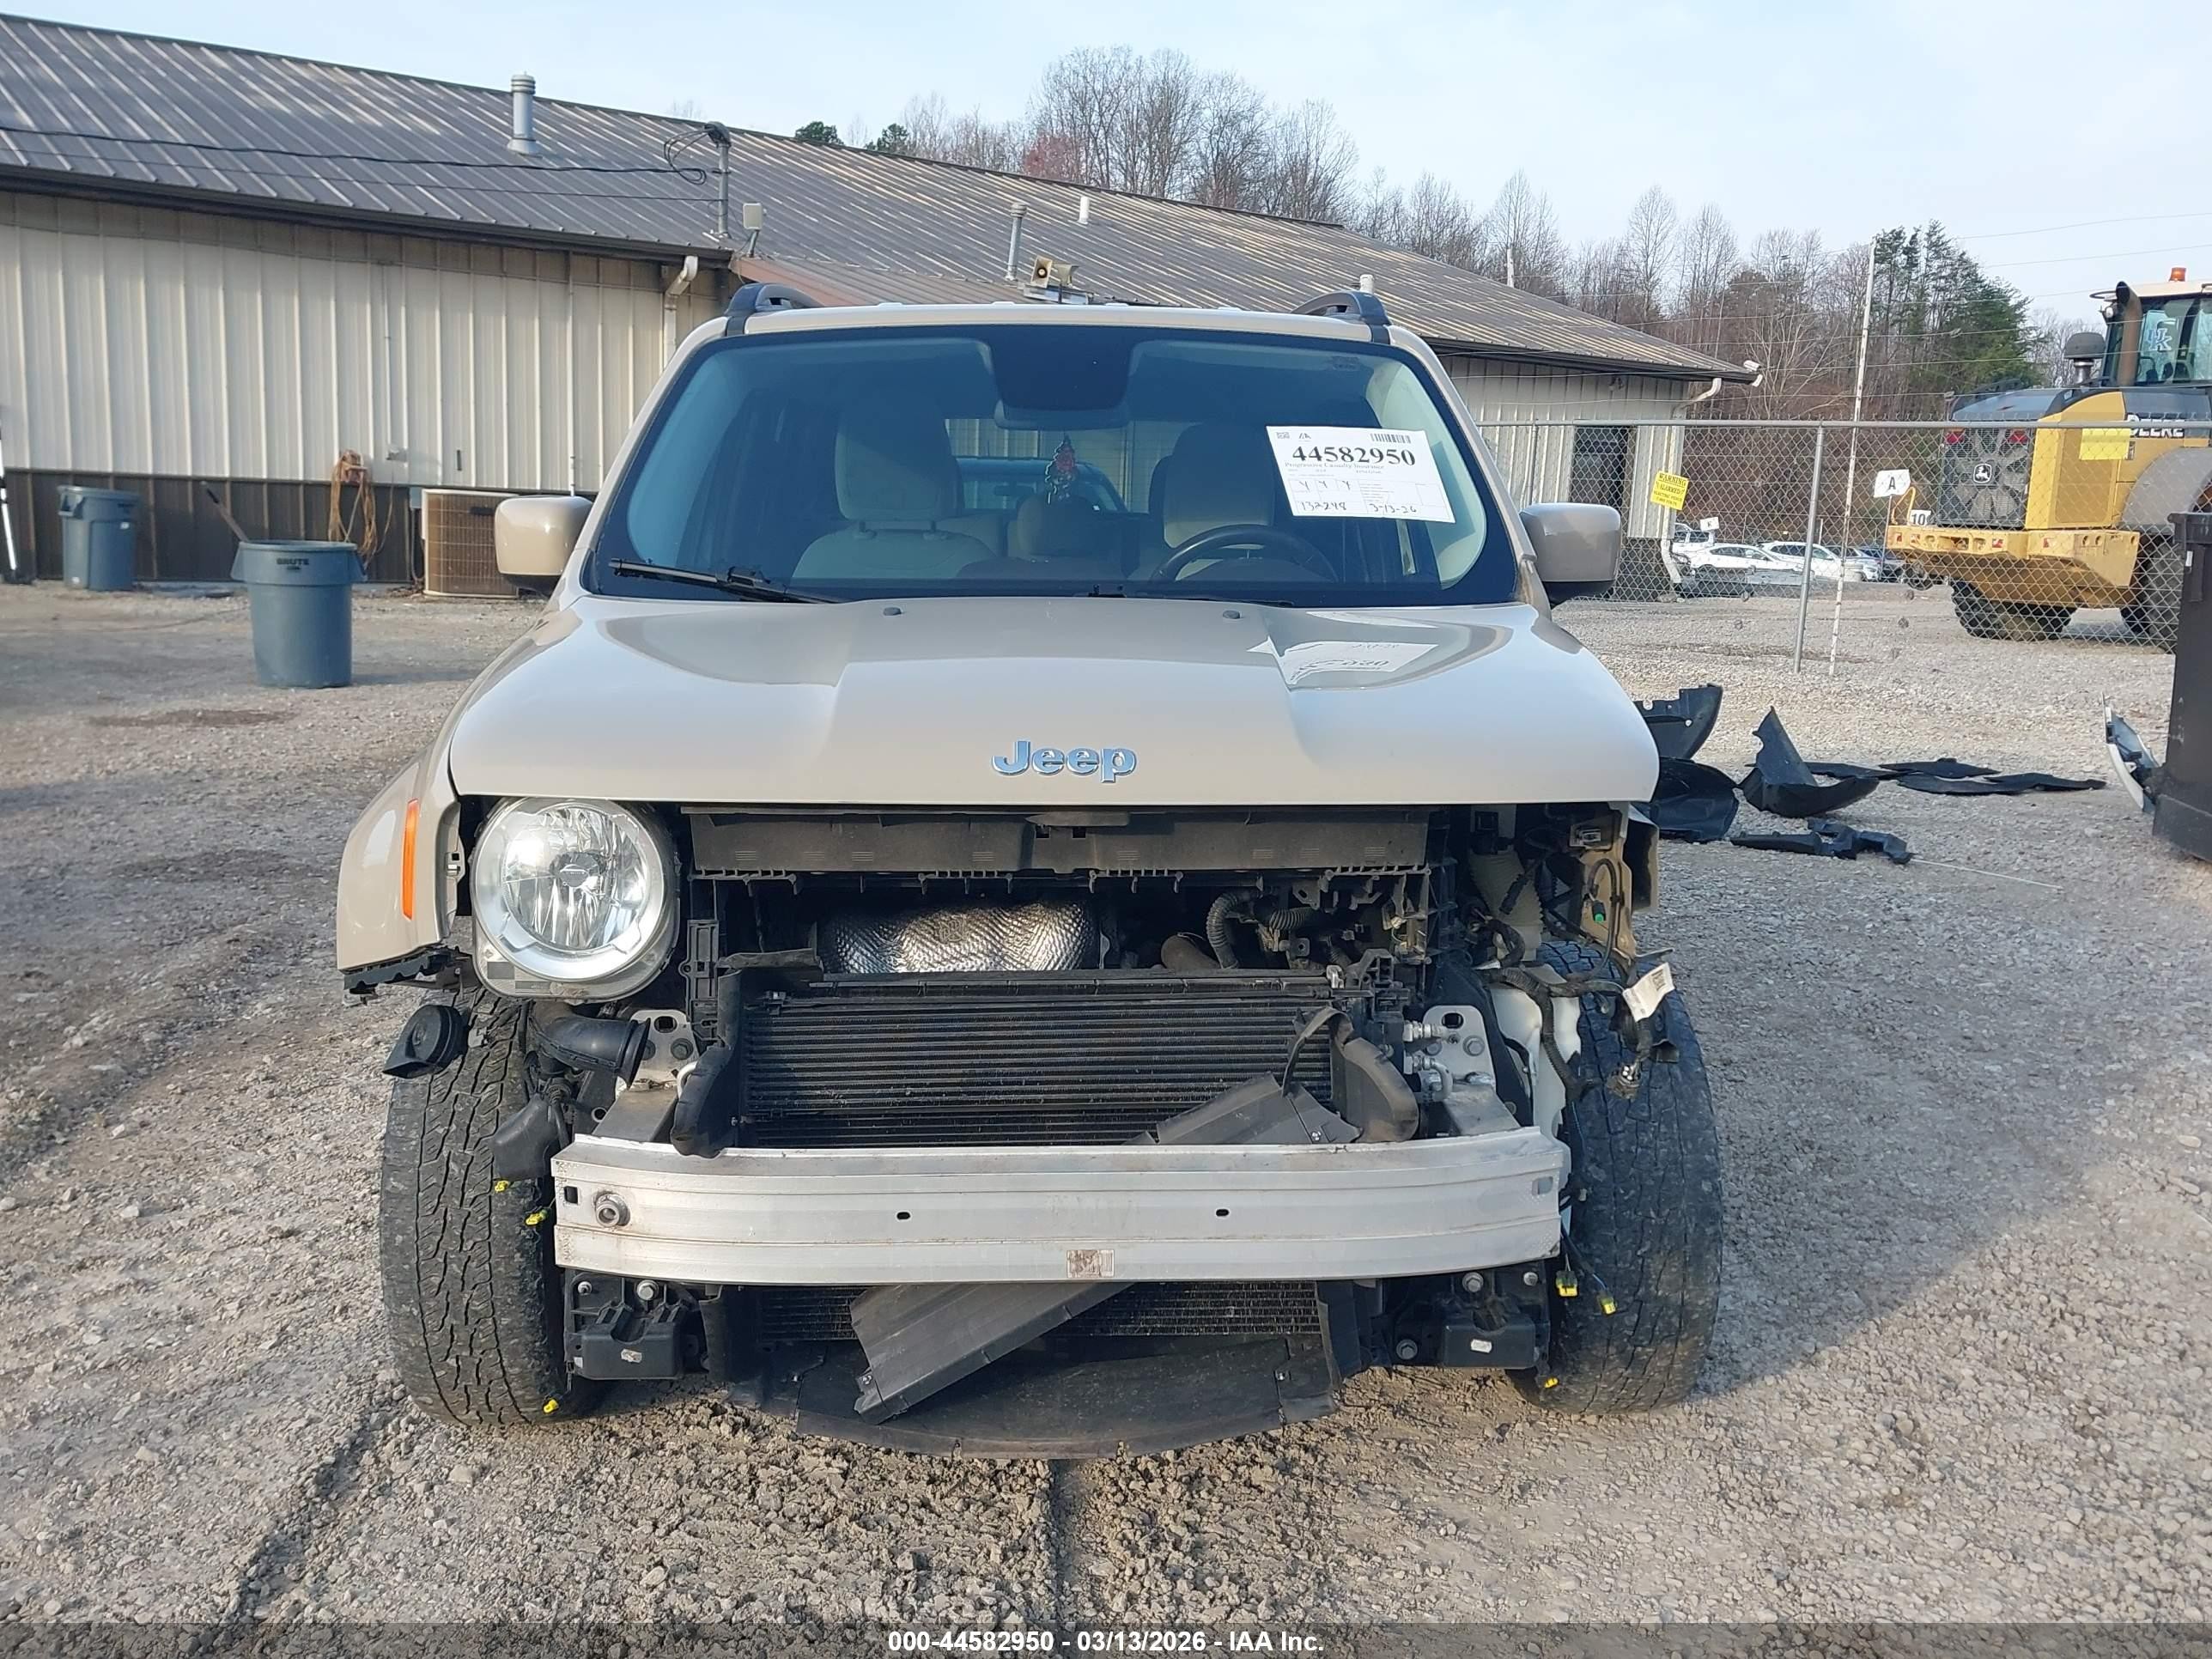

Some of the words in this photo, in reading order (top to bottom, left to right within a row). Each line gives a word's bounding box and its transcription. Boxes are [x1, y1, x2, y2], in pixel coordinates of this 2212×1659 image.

[1292, 446, 1415, 465] 44582950
[1659, 473, 1686, 486] WARNING
[1889, 477, 1896, 490] A
[991, 739, 1138, 784] Jeep
